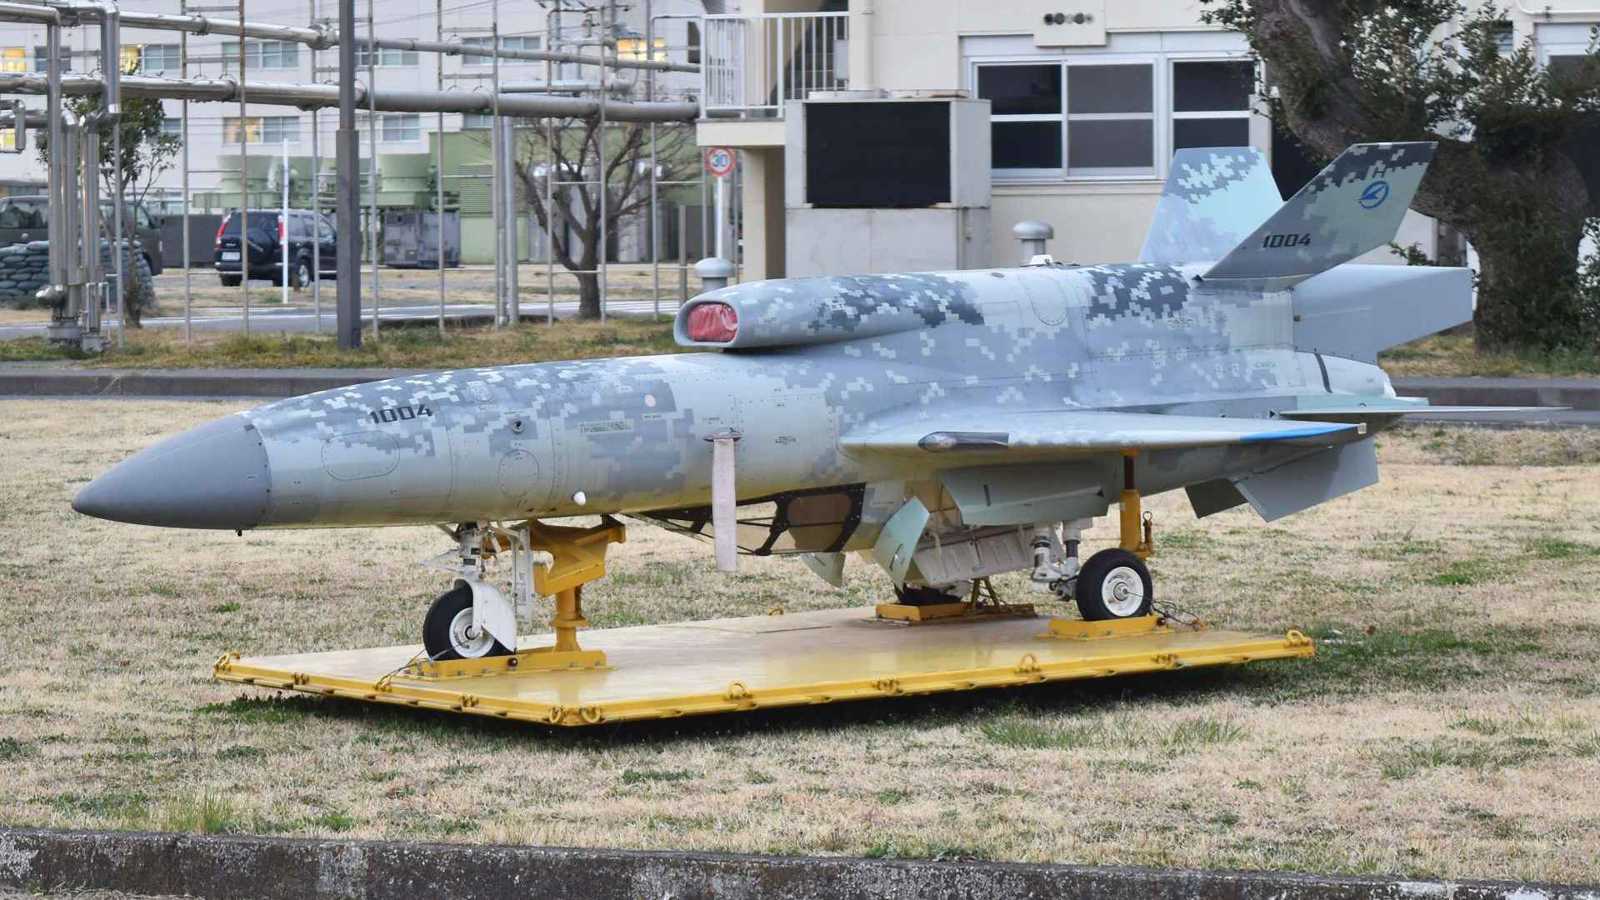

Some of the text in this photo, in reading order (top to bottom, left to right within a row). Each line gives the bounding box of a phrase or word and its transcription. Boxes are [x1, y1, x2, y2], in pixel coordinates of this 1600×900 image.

[712, 154, 729, 168] 30
[1263, 233, 1311, 248] 1004
[370, 404, 432, 424] 1004
